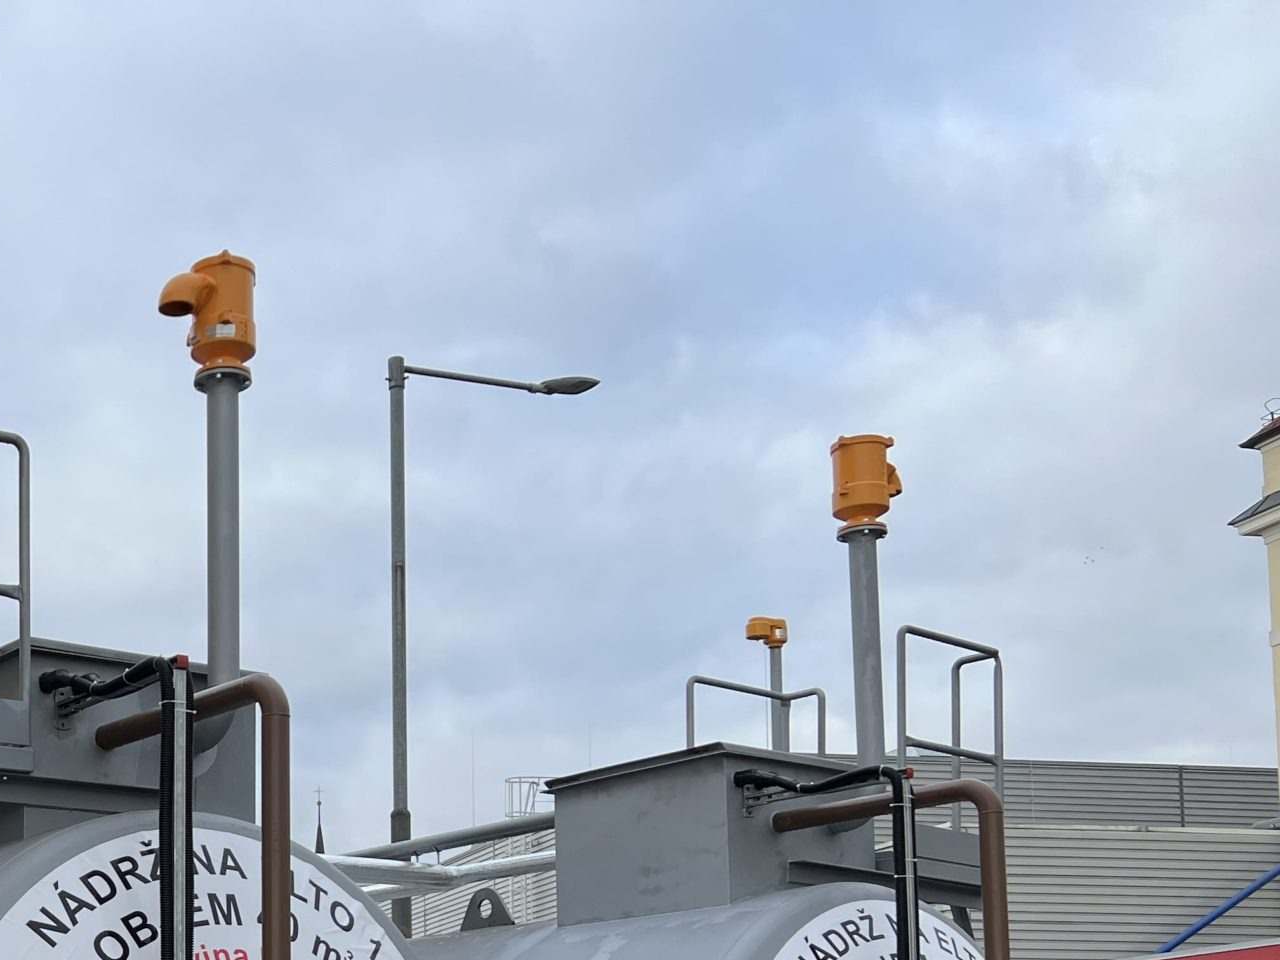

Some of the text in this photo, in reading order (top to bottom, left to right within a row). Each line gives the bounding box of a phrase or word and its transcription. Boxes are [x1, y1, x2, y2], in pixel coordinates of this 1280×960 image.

[26, 839, 160, 948] NÁDRŽ
[193, 844, 248, 880] NA
[290, 869, 355, 932] LTO
